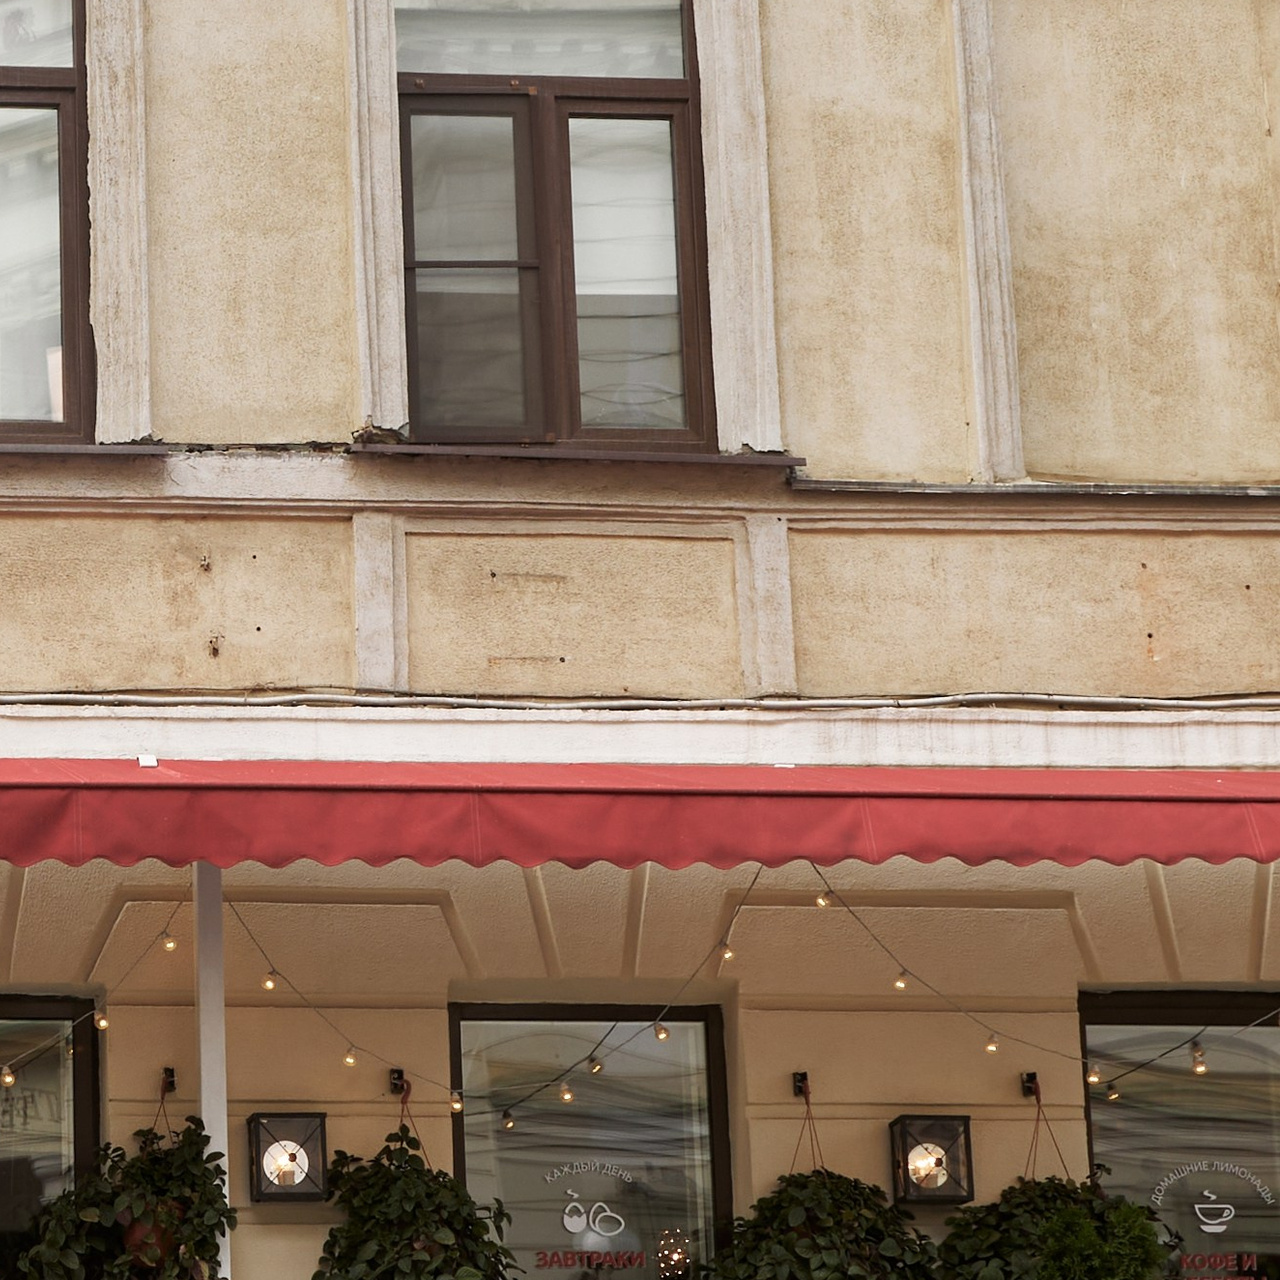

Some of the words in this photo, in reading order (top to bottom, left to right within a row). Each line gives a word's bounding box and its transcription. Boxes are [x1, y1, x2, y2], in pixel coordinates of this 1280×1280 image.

[544, 1159, 600, 1184] КАЖДЫЙ
[601, 1162, 634, 1183] ДЕНЬ
[1151, 1160, 1210, 1207] ДОМАШНИЕ
[1212, 1161, 1276, 1206] ЛИМОНАДЫ
[536, 1250, 646, 1270] ЗАВТРАКИ
[1180, 1252, 1238, 1271] КОФЕ
[1242, 1253, 1258, 1271] И
